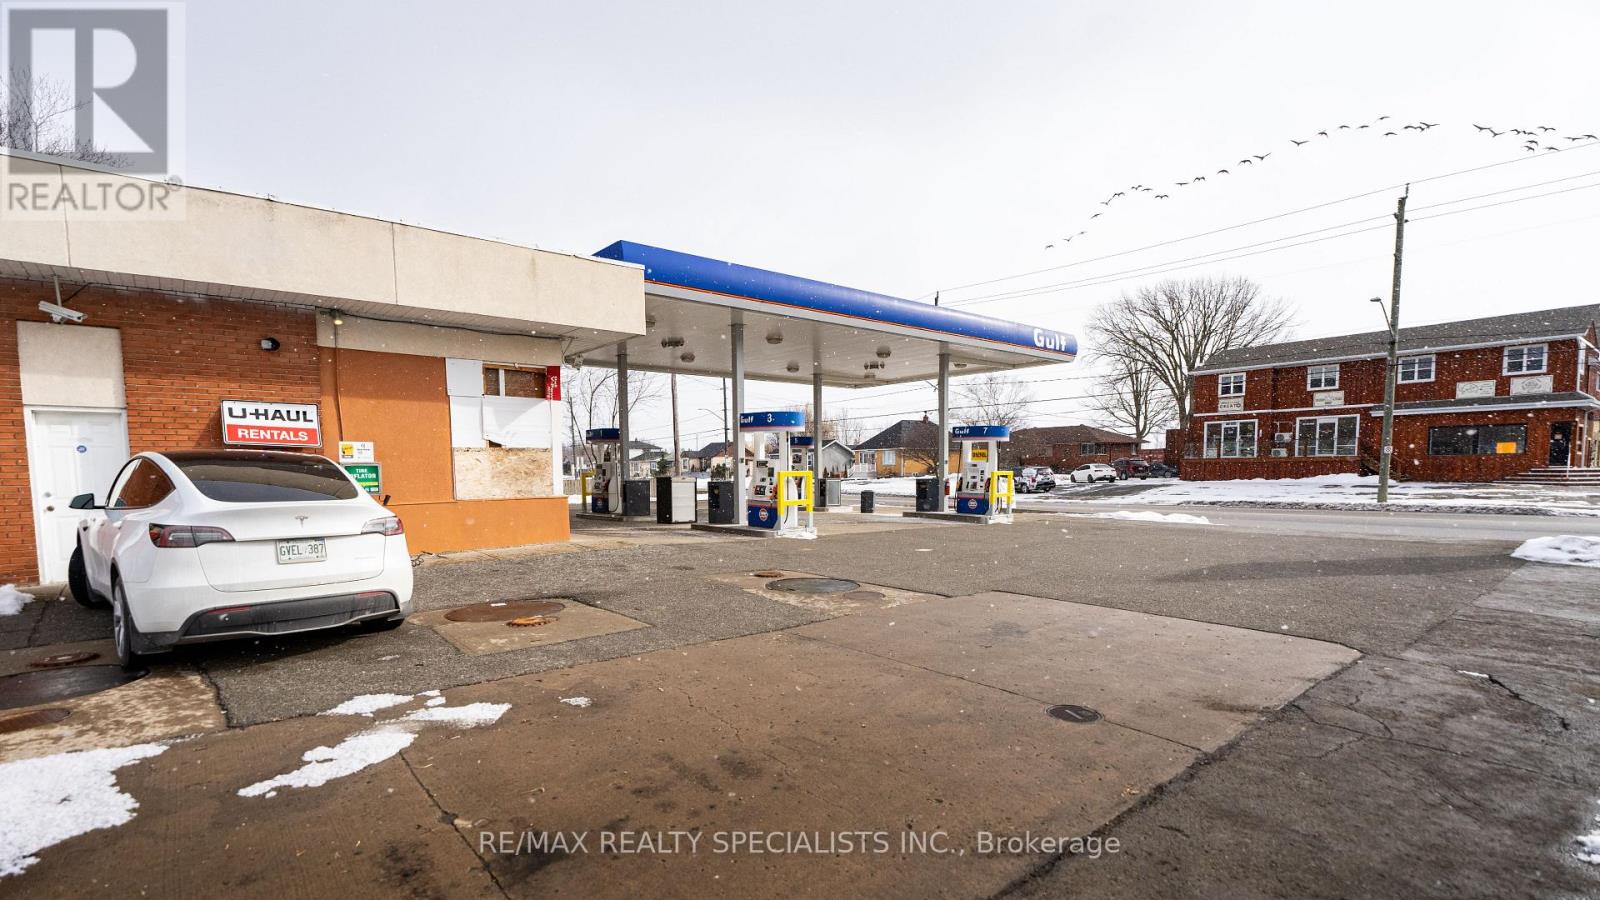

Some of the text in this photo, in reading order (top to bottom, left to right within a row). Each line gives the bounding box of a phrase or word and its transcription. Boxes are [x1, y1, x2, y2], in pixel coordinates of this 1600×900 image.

[1033, 328, 1067, 352] Gulf
[227, 406, 314, 423] U-HAUL
[767, 413, 773, 423] 3
[237, 428, 309, 441] RENTALS
[983, 427, 988, 435] 7
[279, 543, 324, 556] GVEL 387
